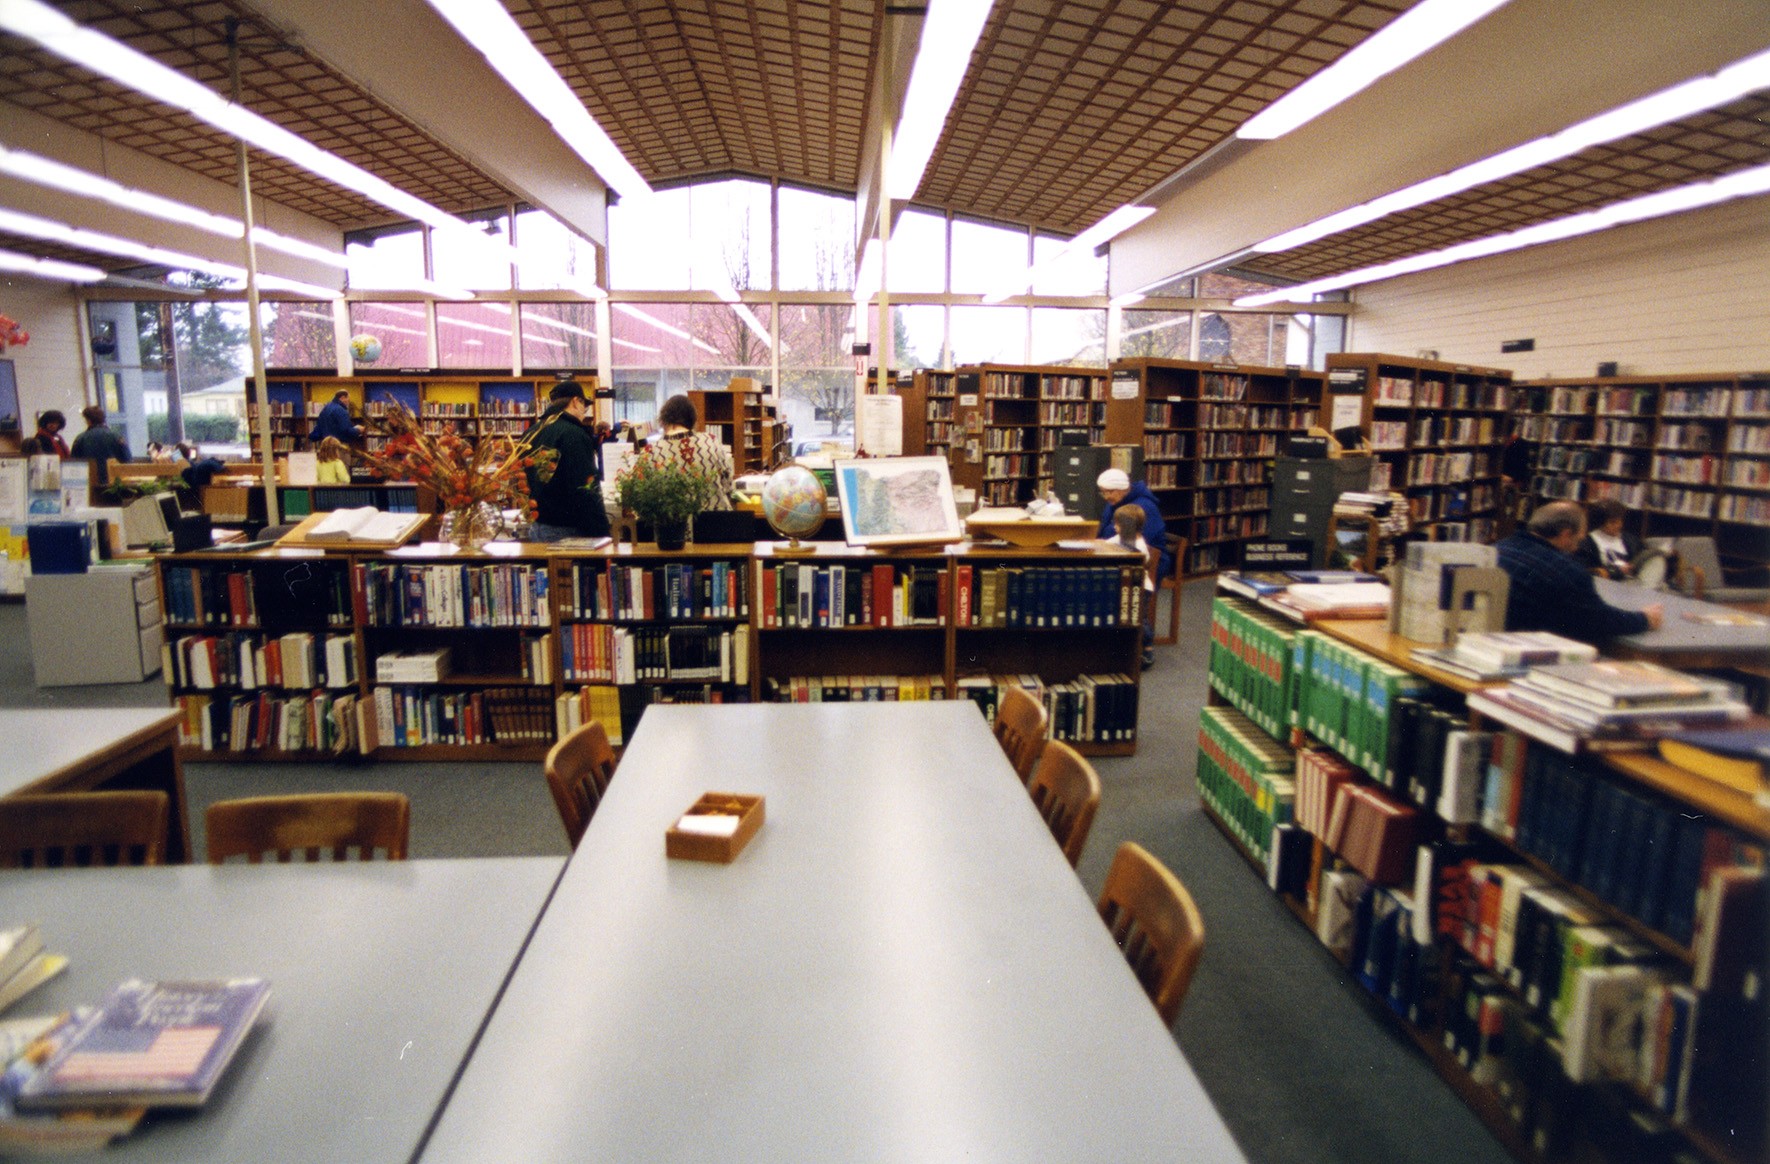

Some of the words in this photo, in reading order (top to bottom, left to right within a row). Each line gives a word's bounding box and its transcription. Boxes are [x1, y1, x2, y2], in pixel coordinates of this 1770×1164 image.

[1245, 552, 1274, 560] BUSINESS
[1275, 552, 1308, 560] REFERENCE
[960, 586, 968, 620] CHILTON
[1121, 586, 1129, 621] CHILTON
